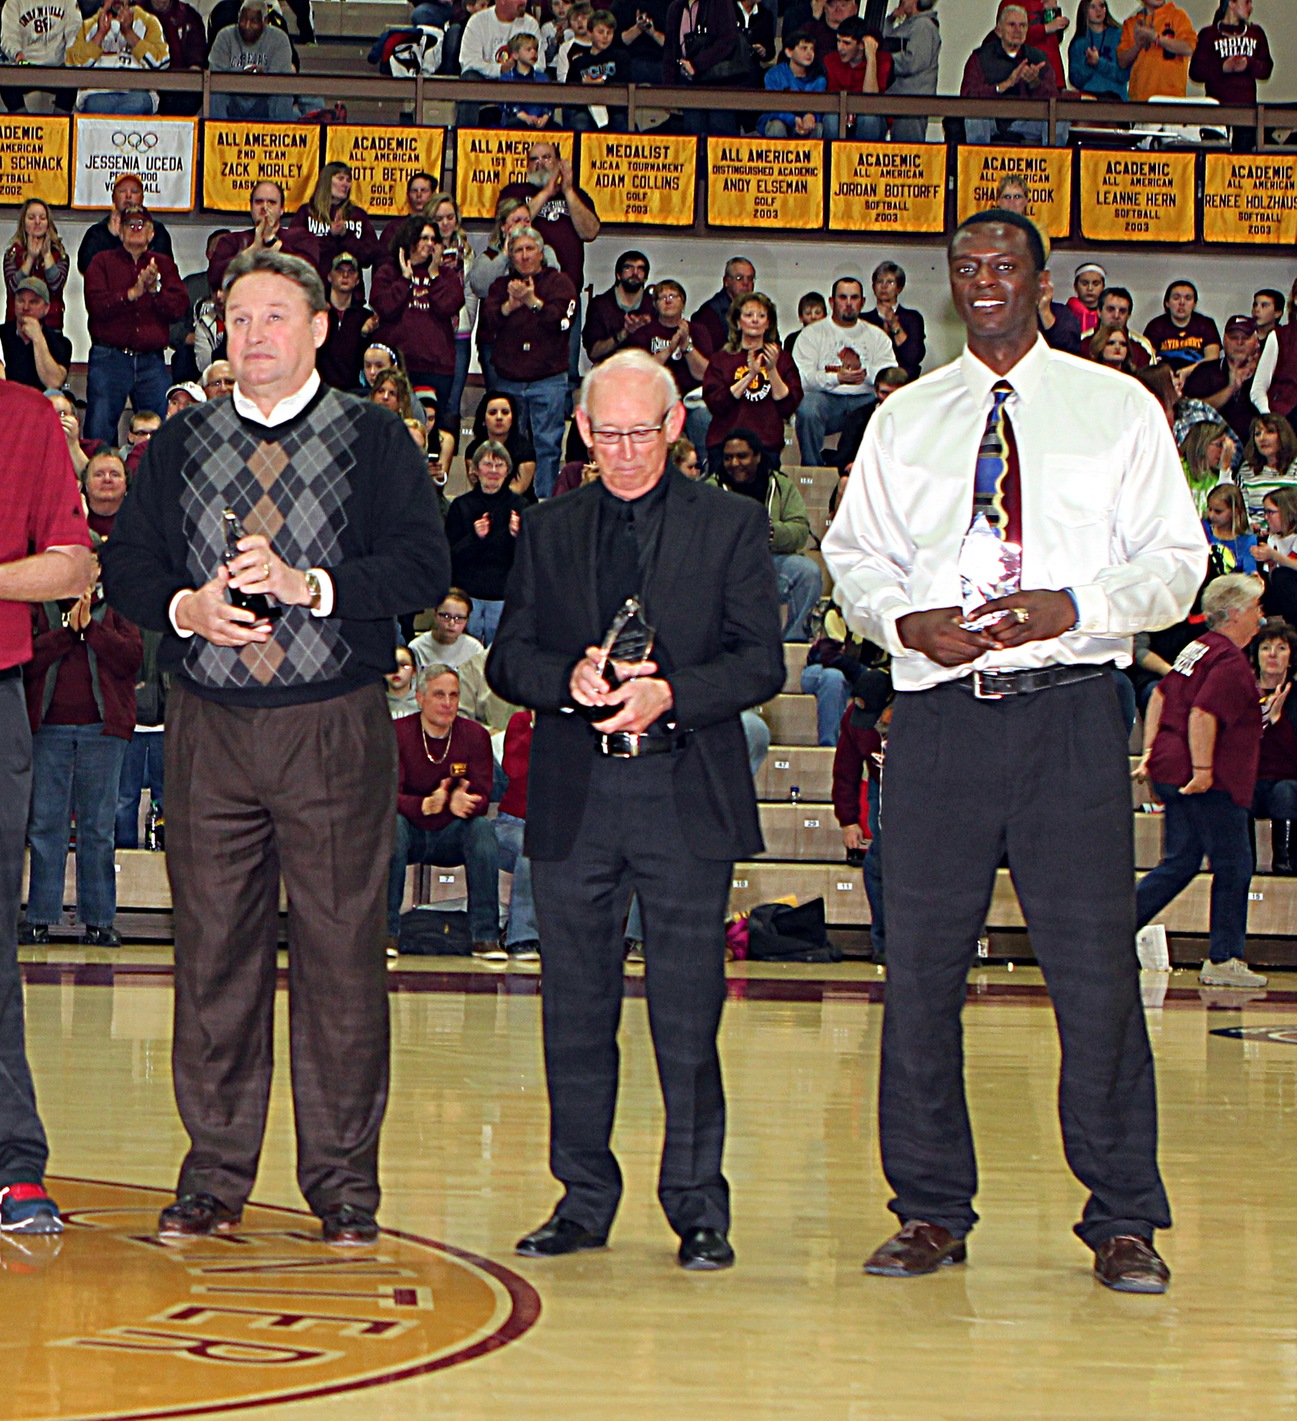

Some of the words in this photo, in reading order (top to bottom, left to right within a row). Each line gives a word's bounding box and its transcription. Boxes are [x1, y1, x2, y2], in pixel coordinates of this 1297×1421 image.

[1214, 37, 1257, 50] INDIAN
[217, 132, 239, 146] ALL
[244, 133, 307, 148] AMERICAN
[353, 137, 418, 151] ACADEMIC
[0, 144, 43, 153] AMERICAN
[471, 140, 492, 153] ALL
[606, 144, 670, 159] MEDALIST
[237, 151, 255, 159] 2ND
[264, 151, 286, 160] TEAM
[349, 152, 366, 161] ALL
[374, 153, 419, 163] AMERICAN
[721, 149, 742, 162] ALL
[747, 150, 811, 164] AMERICAN
[857, 154, 920, 167] ACADEMIC
[11, 157, 62, 170] SCHNACK
[86, 156, 139, 170] JESSENIA
[146, 157, 183, 171] UCEDA
[492, 158, 505, 167] 1ST
[515, 159, 526, 168] TE
[592, 161, 620, 170] NJCAA
[628, 162, 684, 172] TOURNAMENT
[983, 157, 1047, 172] ACADEMIC
[1106, 161, 1170, 176] ACADEMIC
[221, 162, 249, 177] ZACK
[258, 164, 302, 178] MORLEY
[350, 167, 374, 181] OTT
[713, 166, 774, 176] DISTINGUISHED
[778, 167, 818, 176] ACADEMIC
[854, 168, 870, 177] ALL
[880, 169, 923, 178] AMERICAN
[1231, 165, 1293, 179] ACADEMIC
[472, 170, 500, 184] ADAM
[596, 175, 625, 188] ADAM
[632, 176, 679, 189] COLLINS
[980, 172, 996, 181] ALL
[723, 178, 750, 193] ANDY
[757, 180, 807, 194] ELSEMAN
[1103, 177, 1119, 186] ALL
[1130, 178, 1173, 188] AMERICAN
[1228, 180, 1243, 189] ALL
[1253, 181, 1295, 190] AMERICAN
[0, 186, 22, 195] 2002
[371, 185, 394, 195] GOLF
[834, 182, 877, 197] JORDAN
[885, 184, 940, 198] BOTTORFF
[370, 197, 393, 206] 2003
[627, 192, 647, 201] GOLF
[754, 198, 776, 206] GOLF
[1097, 192, 1141, 206] LEANNE
[1146, 193, 1176, 207] HERN
[1206, 194, 1240, 208] RENEE
[626, 205, 647, 214] 2003
[865, 201, 909, 210] SOFTBALL
[753, 210, 778, 218] 2003
[875, 213, 898, 222] 2003
[1115, 209, 1160, 219] SOFTBALL
[1239, 212, 1281, 222] SOFTBALL
[1125, 222, 1149, 231] 2003
[1248, 226, 1271, 235] 2003
